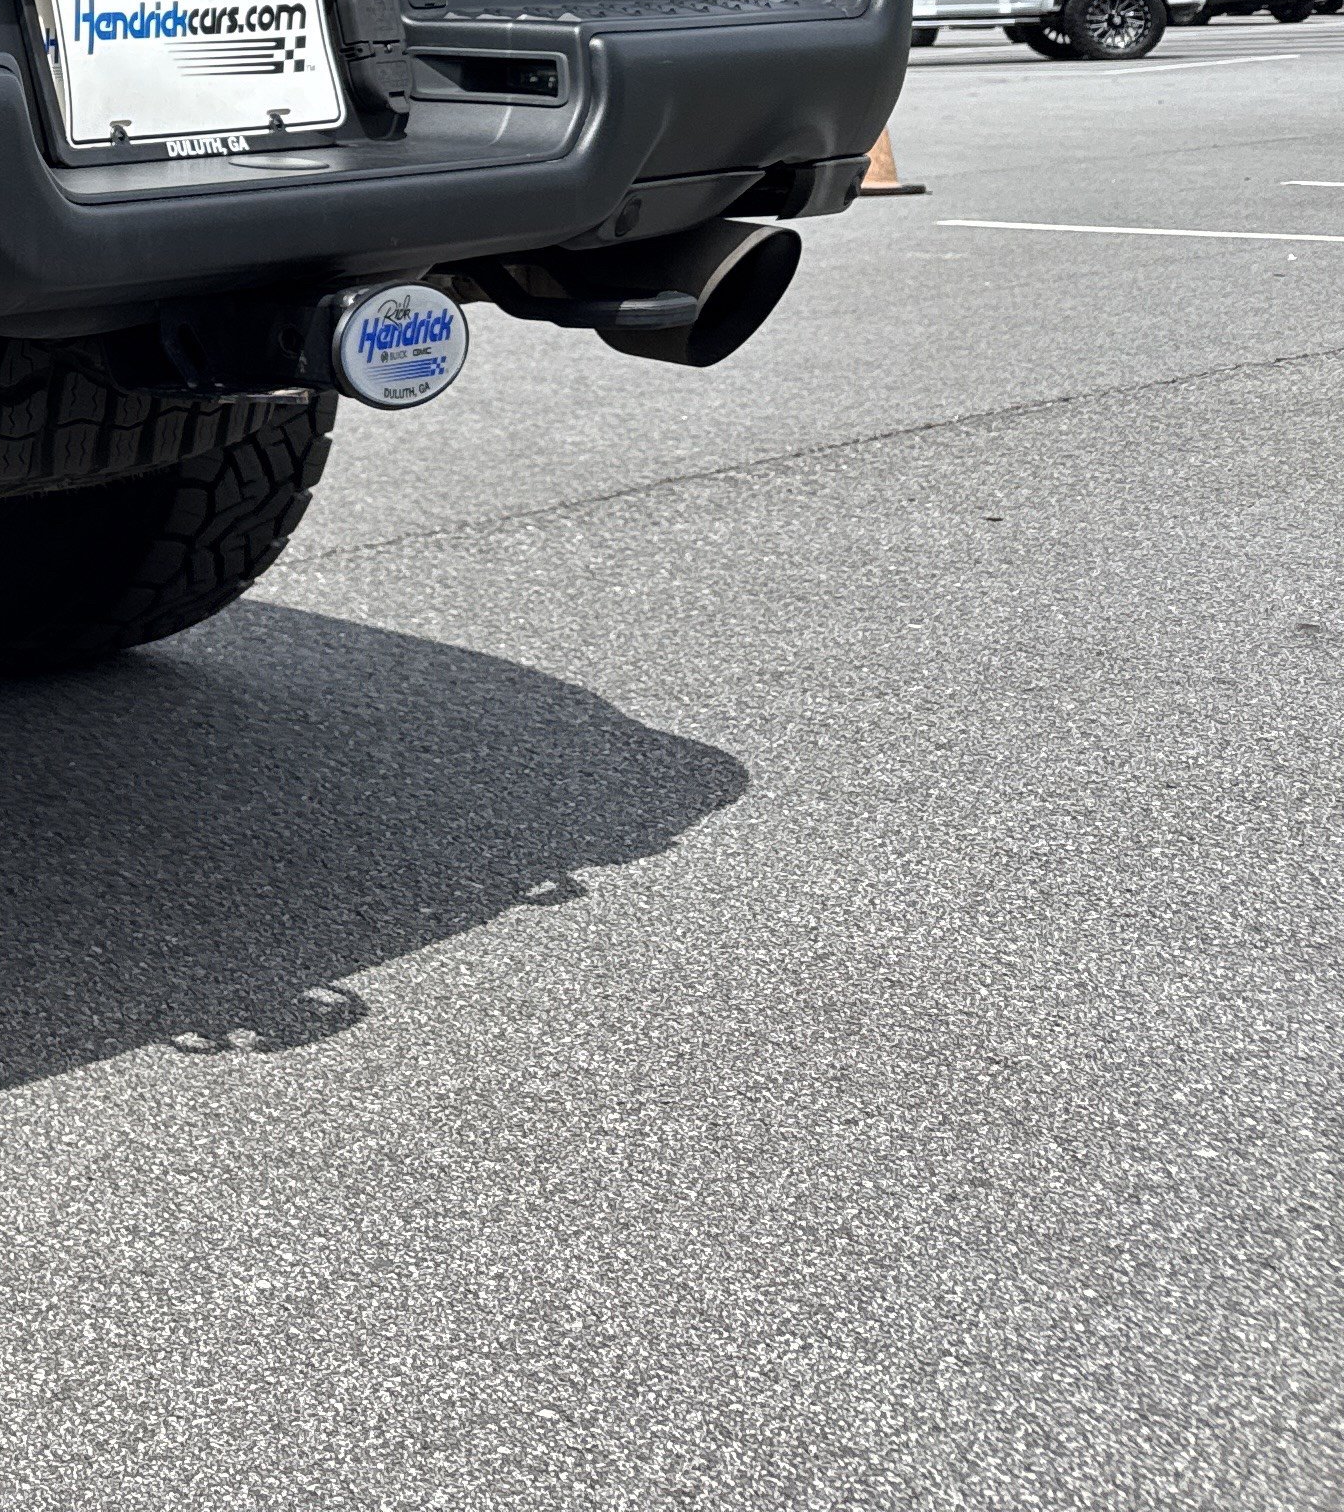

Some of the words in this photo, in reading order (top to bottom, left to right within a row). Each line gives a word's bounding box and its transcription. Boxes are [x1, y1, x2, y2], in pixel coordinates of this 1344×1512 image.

[166, 138, 228, 157] DULUTH,
[228, 135, 250, 152] GA
[378, 295, 411, 326] Rick
[358, 308, 454, 363] Hendrick
[419, 382, 431, 394] GA
